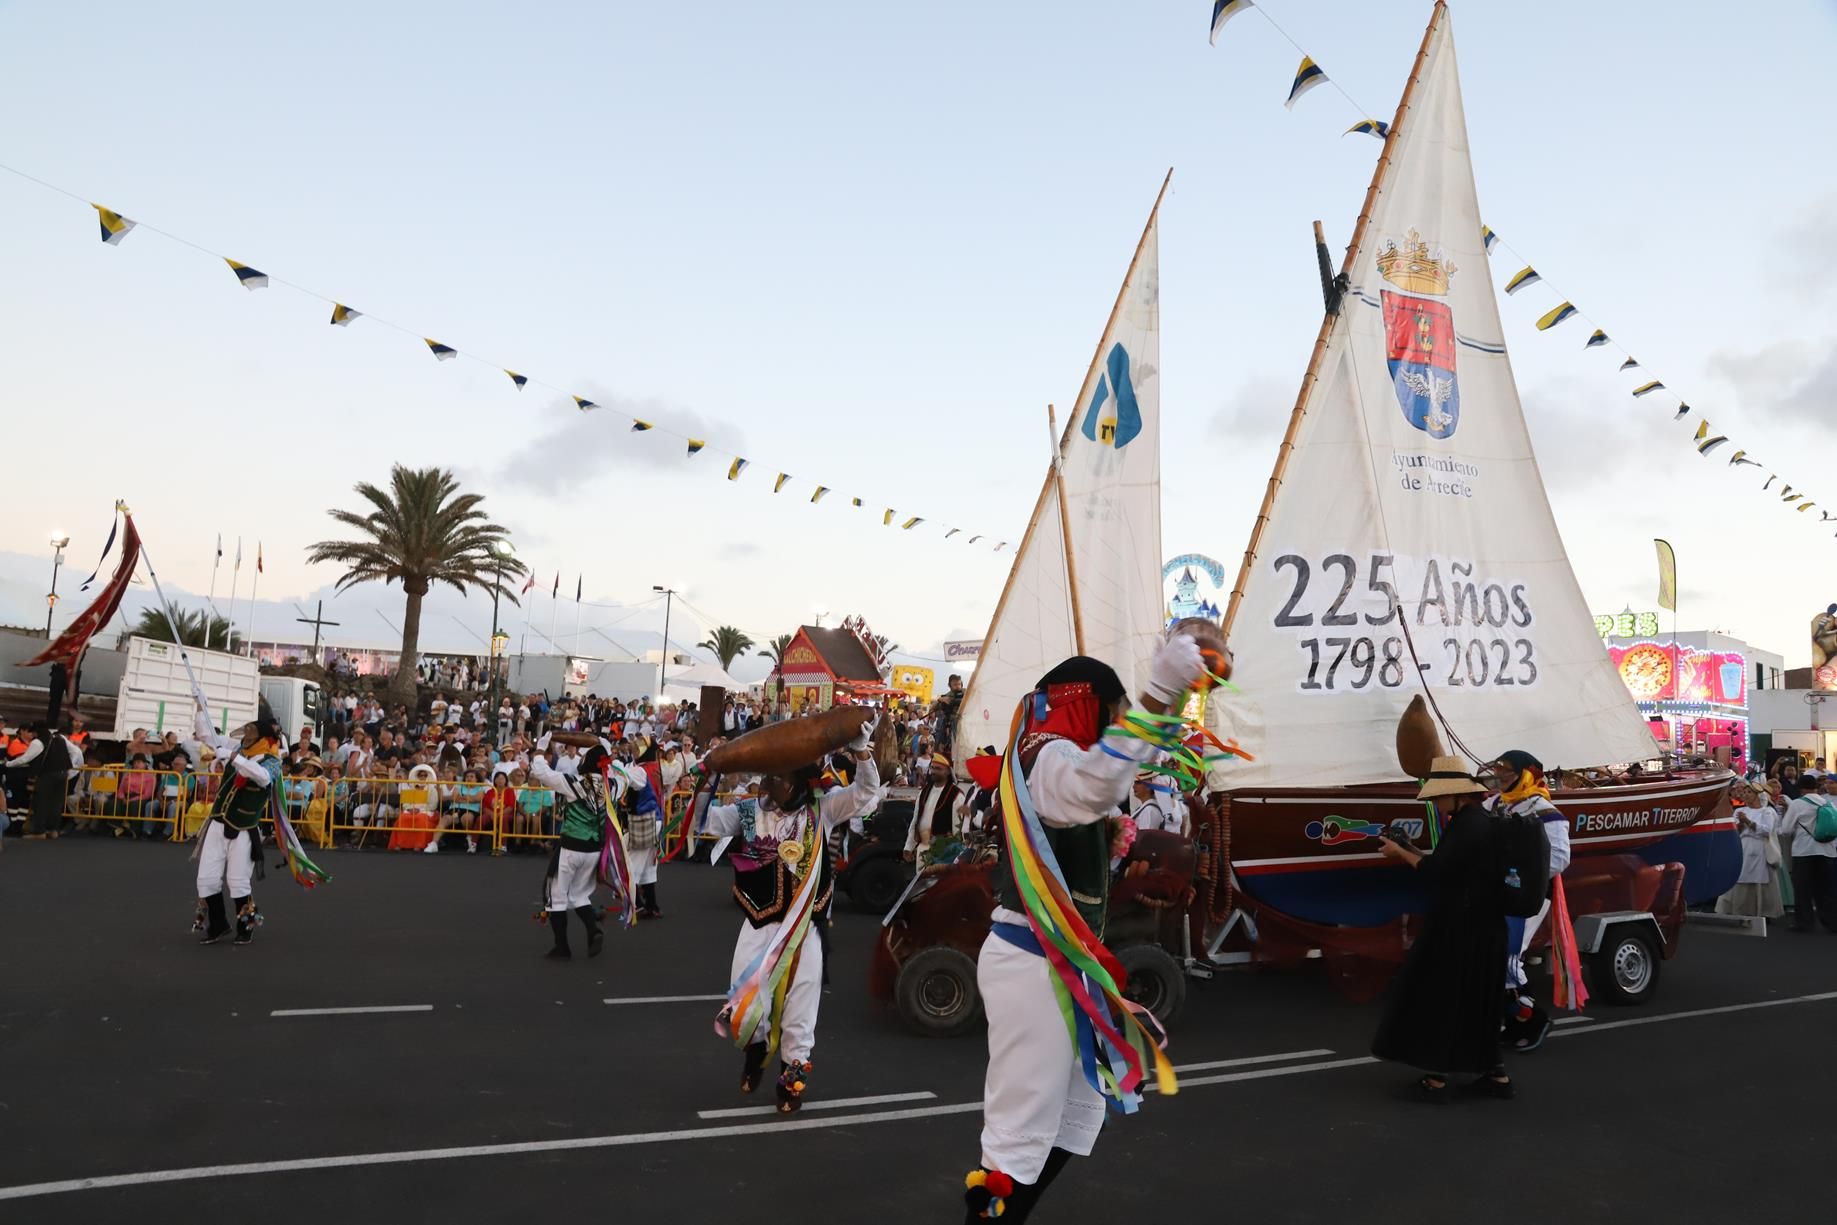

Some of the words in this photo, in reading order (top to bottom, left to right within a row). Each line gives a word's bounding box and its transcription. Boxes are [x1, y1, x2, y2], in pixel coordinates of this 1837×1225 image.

[1401, 473, 1421, 490] de
[1273, 554, 1399, 627] 225
[1416, 559, 1532, 628] Años
[1300, 636, 1403, 690] 1798
[1443, 638, 1537, 687] 2023
[1575, 811, 1650, 832] PESCAMAR
[1652, 806, 1700, 825] TITERROY
